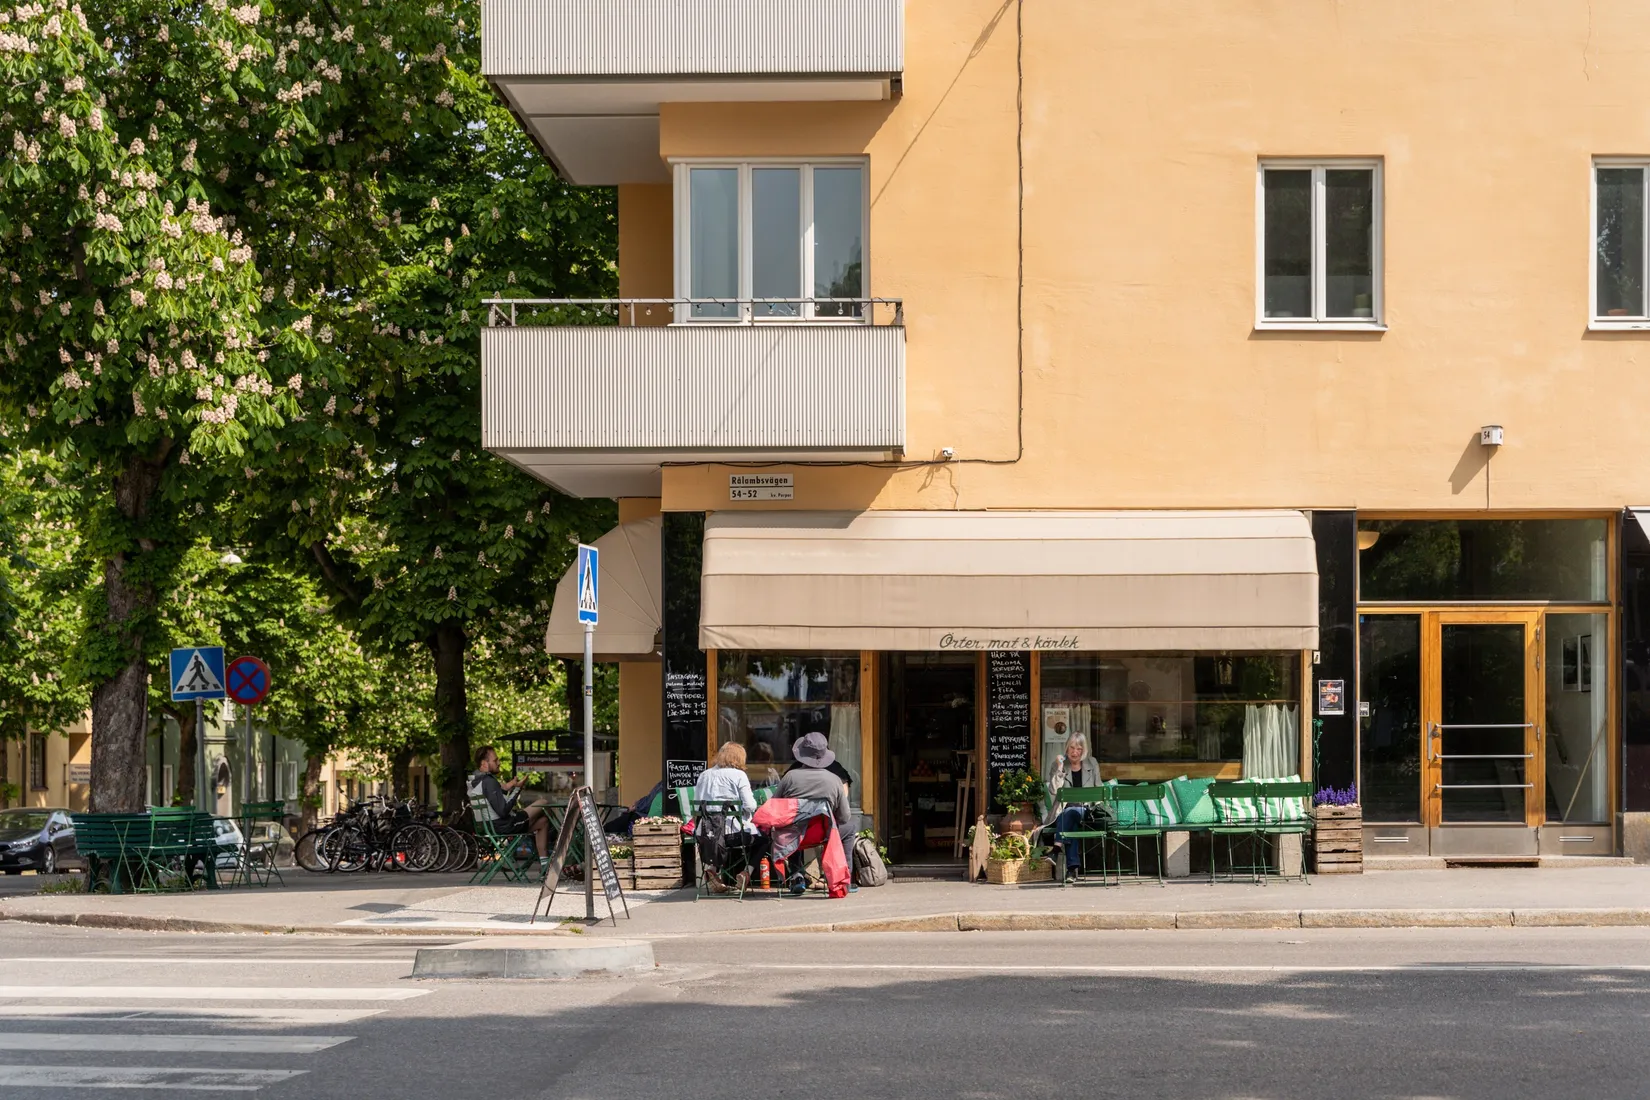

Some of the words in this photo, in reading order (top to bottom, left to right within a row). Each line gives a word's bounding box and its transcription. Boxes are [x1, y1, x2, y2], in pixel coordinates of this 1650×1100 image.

[1483, 430, 1490, 440] 54
[731, 475, 788, 486] Rålambsvägen
[732, 489, 757, 498] 54-52
[987, 636, 1019, 649] mat
[1021, 637, 1031, 648] &
[1033, 635, 1080, 650] kärlek
[996, 679, 1022, 687] LUNCH
